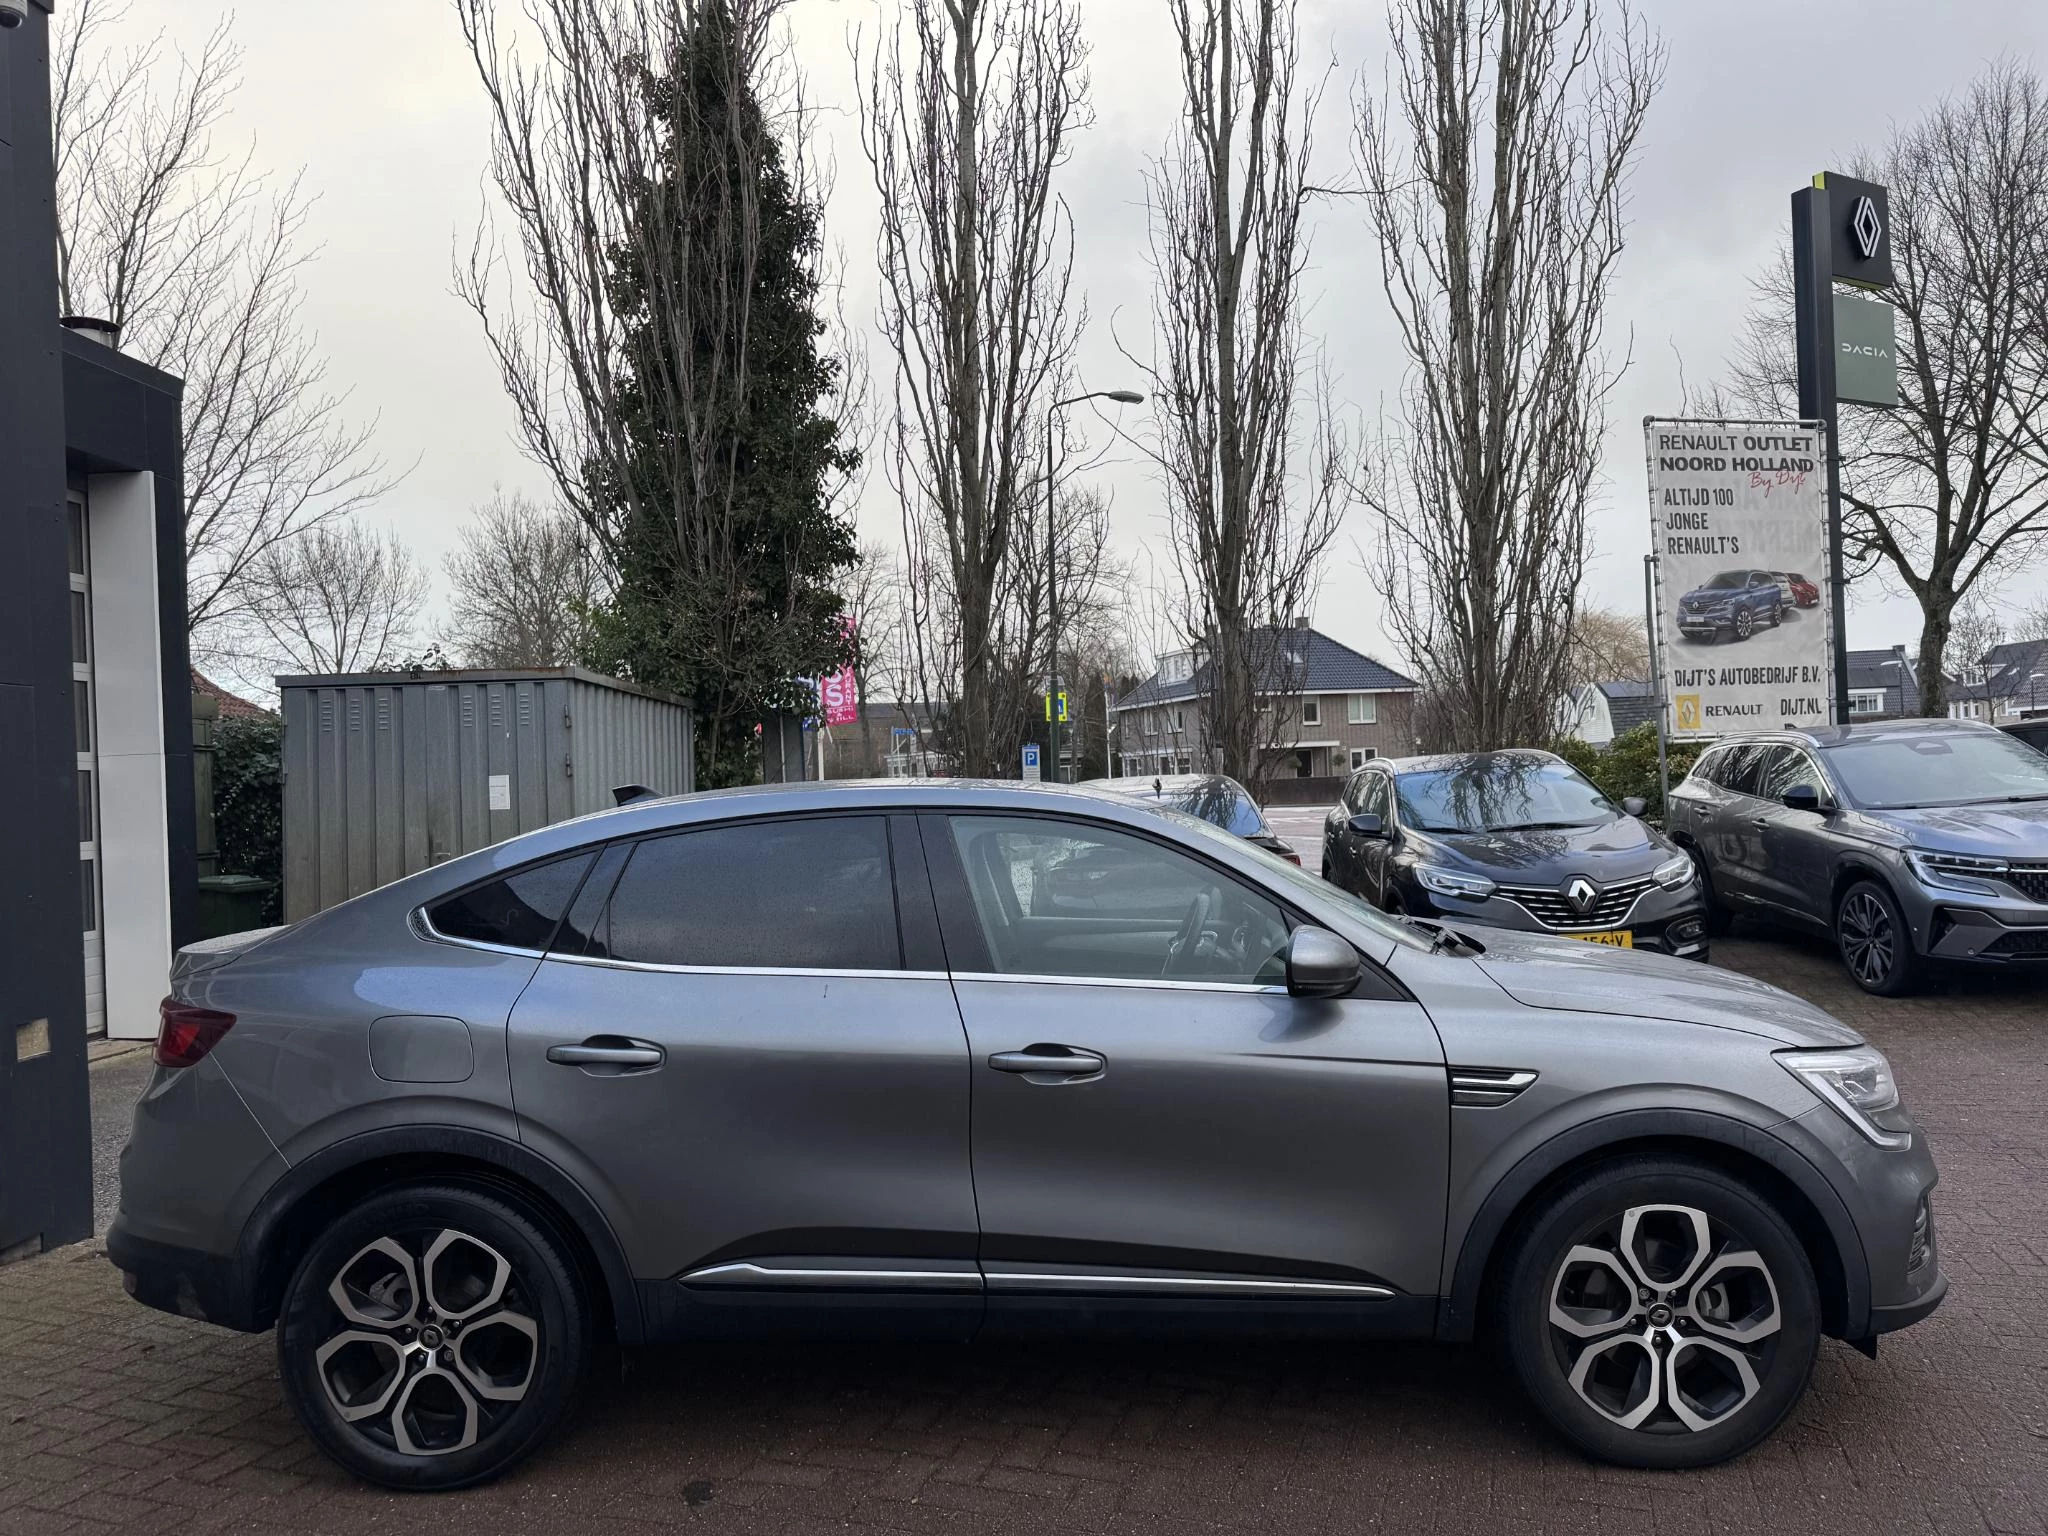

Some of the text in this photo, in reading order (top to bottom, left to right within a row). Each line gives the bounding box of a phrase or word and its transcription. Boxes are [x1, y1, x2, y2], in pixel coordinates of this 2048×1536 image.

[1841, 343, 1888, 358] DACIA
[1659, 434, 1813, 451] RENAULT OUTLET
[1660, 457, 1814, 472] NOORD HOLLAND
[1747, 471, 1774, 498] By
[1664, 488, 1710, 506] ALTIJD
[1713, 488, 1734, 506] 100
[1666, 512, 1709, 530] JONGE
[1668, 536, 1739, 554] RENAULT'S
[1674, 666, 1821, 687] DIJT'S AUTOBEDRIJF B.V.
[1706, 698, 1822, 716] RENAULT DIJT.NL
[1027, 752, 1035, 765] P
